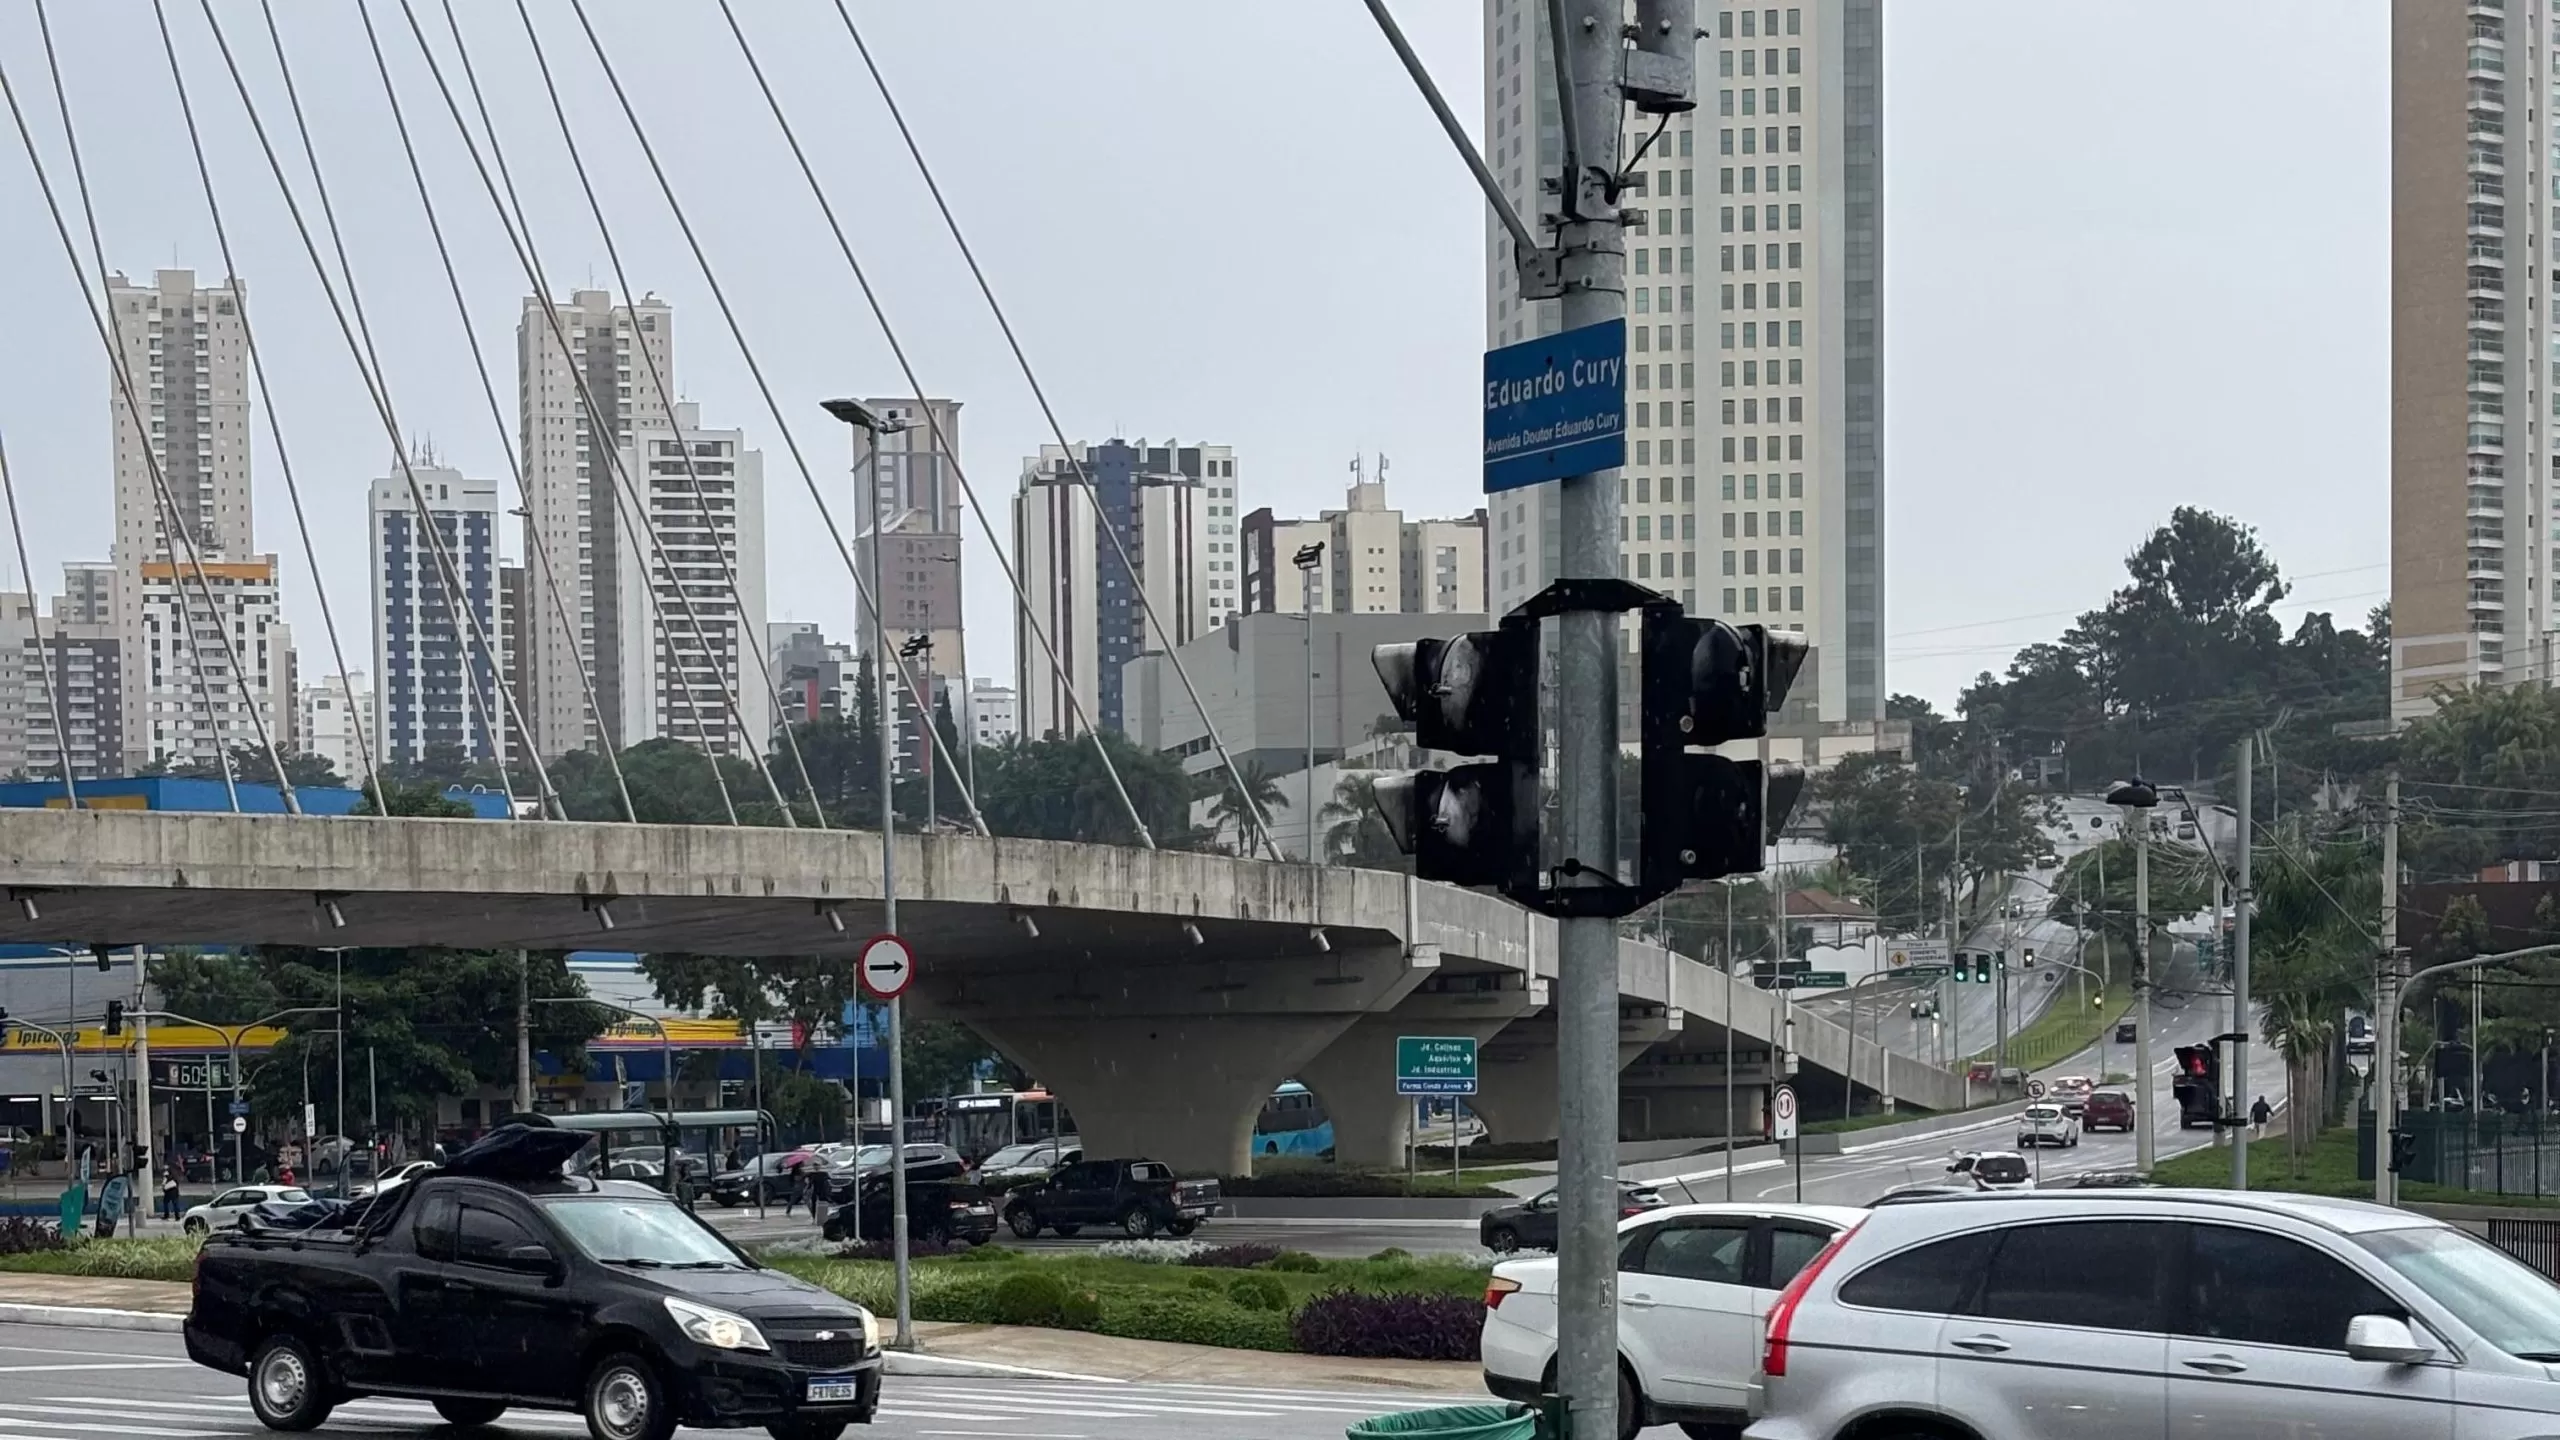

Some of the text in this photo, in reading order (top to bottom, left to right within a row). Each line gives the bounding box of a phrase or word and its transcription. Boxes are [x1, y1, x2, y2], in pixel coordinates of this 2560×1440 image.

[1487, 356, 1621, 410] Eduardo Cury
[1485, 412, 1620, 453] Avenida Doutor Eduardo Cury
